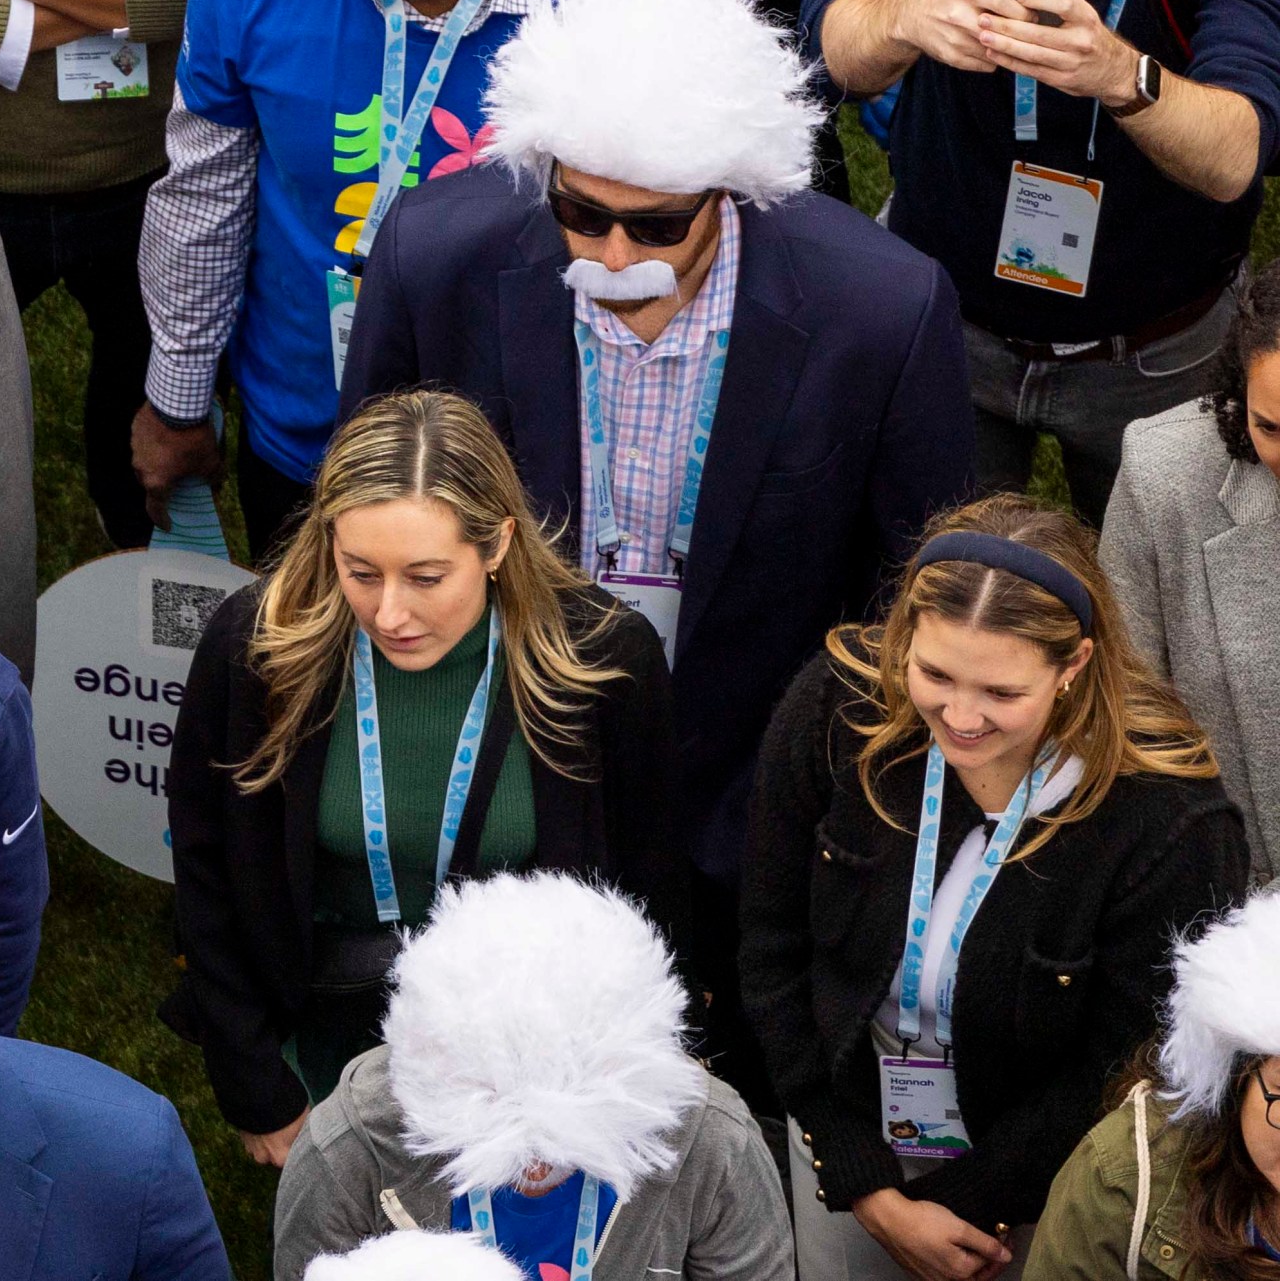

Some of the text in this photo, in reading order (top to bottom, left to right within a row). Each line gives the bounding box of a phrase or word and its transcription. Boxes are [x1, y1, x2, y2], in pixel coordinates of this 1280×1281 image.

[1017, 187, 1052, 202] Jacob
[1016, 196, 1039, 208] Irving
[1003, 268, 1048, 285] Attendee
[890, 1077, 934, 1087] Hannah
